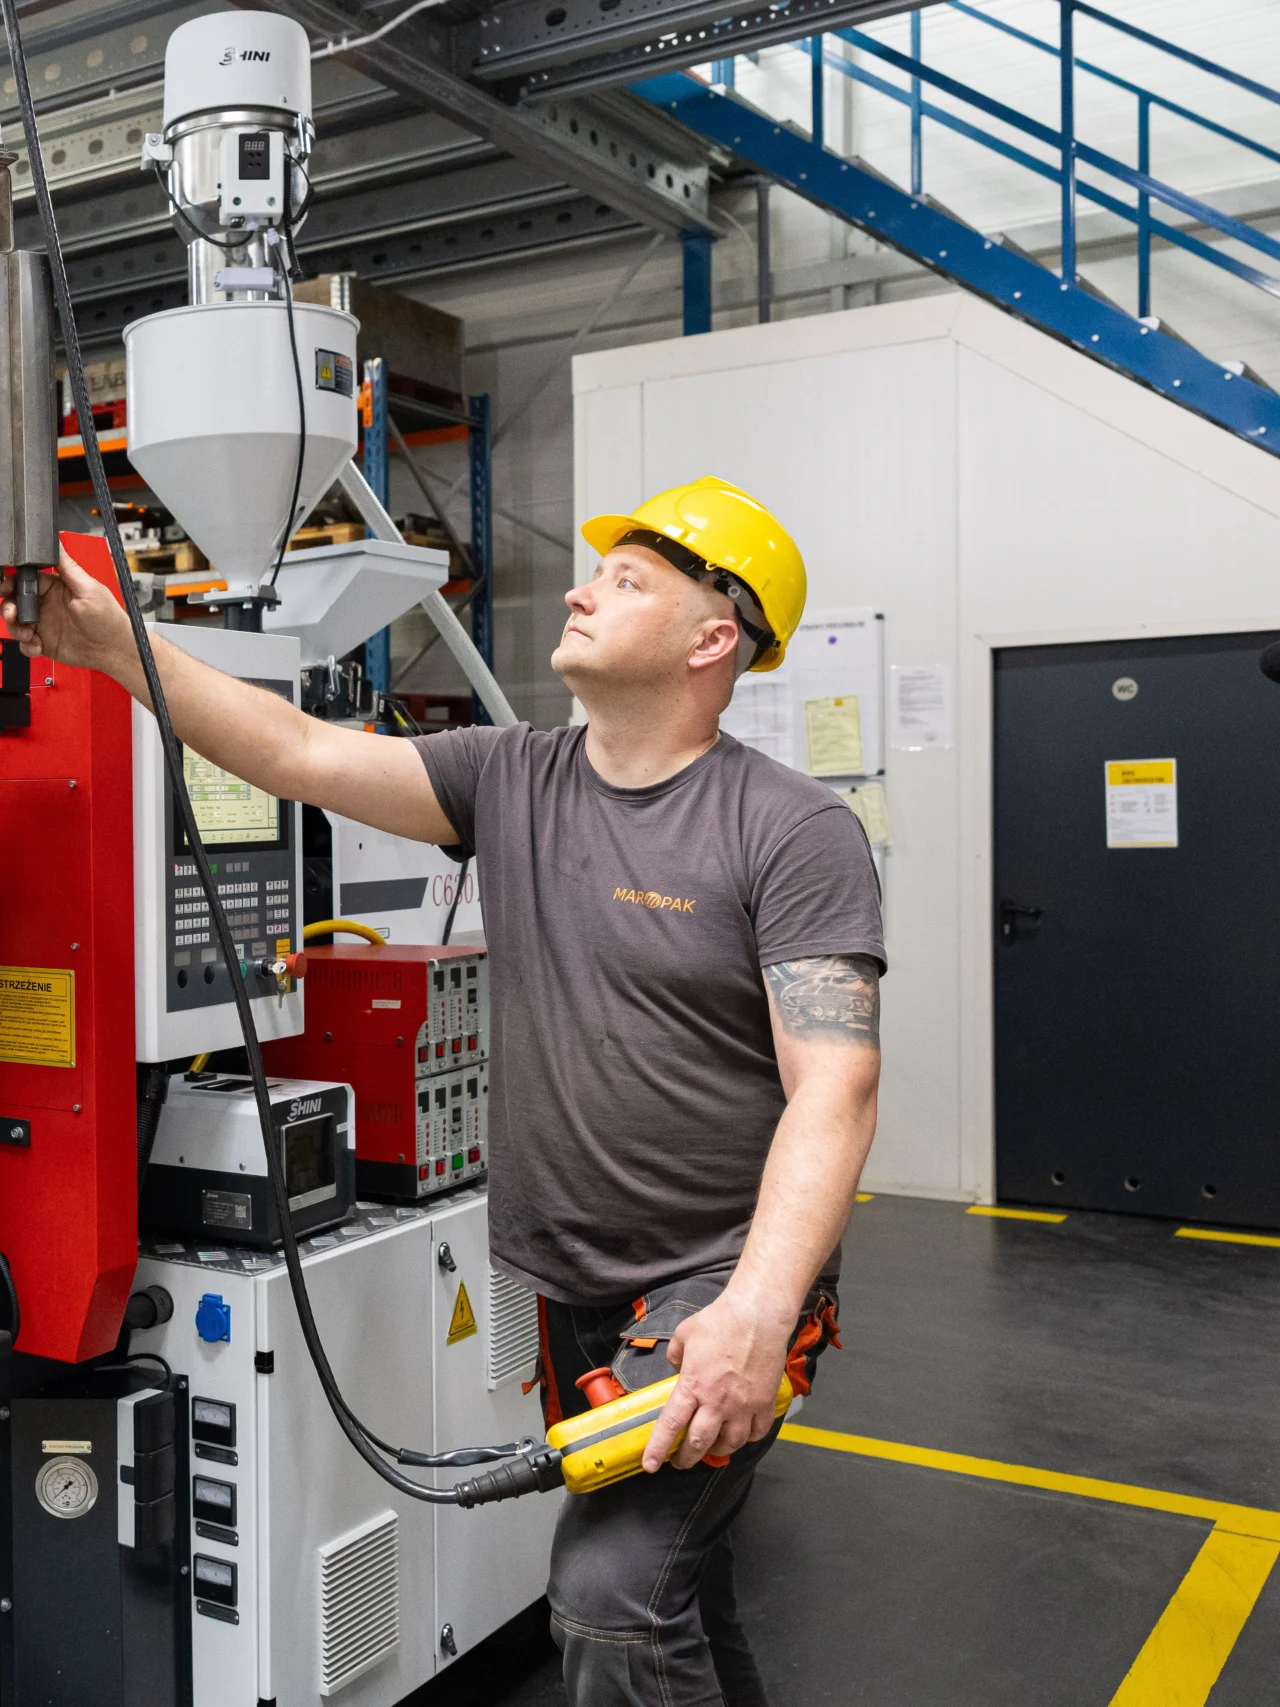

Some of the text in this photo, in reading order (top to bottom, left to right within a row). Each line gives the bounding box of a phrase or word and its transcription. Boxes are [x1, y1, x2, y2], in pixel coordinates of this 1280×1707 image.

[221, 49, 271, 64] SHINI
[1116, 683, 1134, 694] WC
[288, 1098, 322, 1120] SHINI
